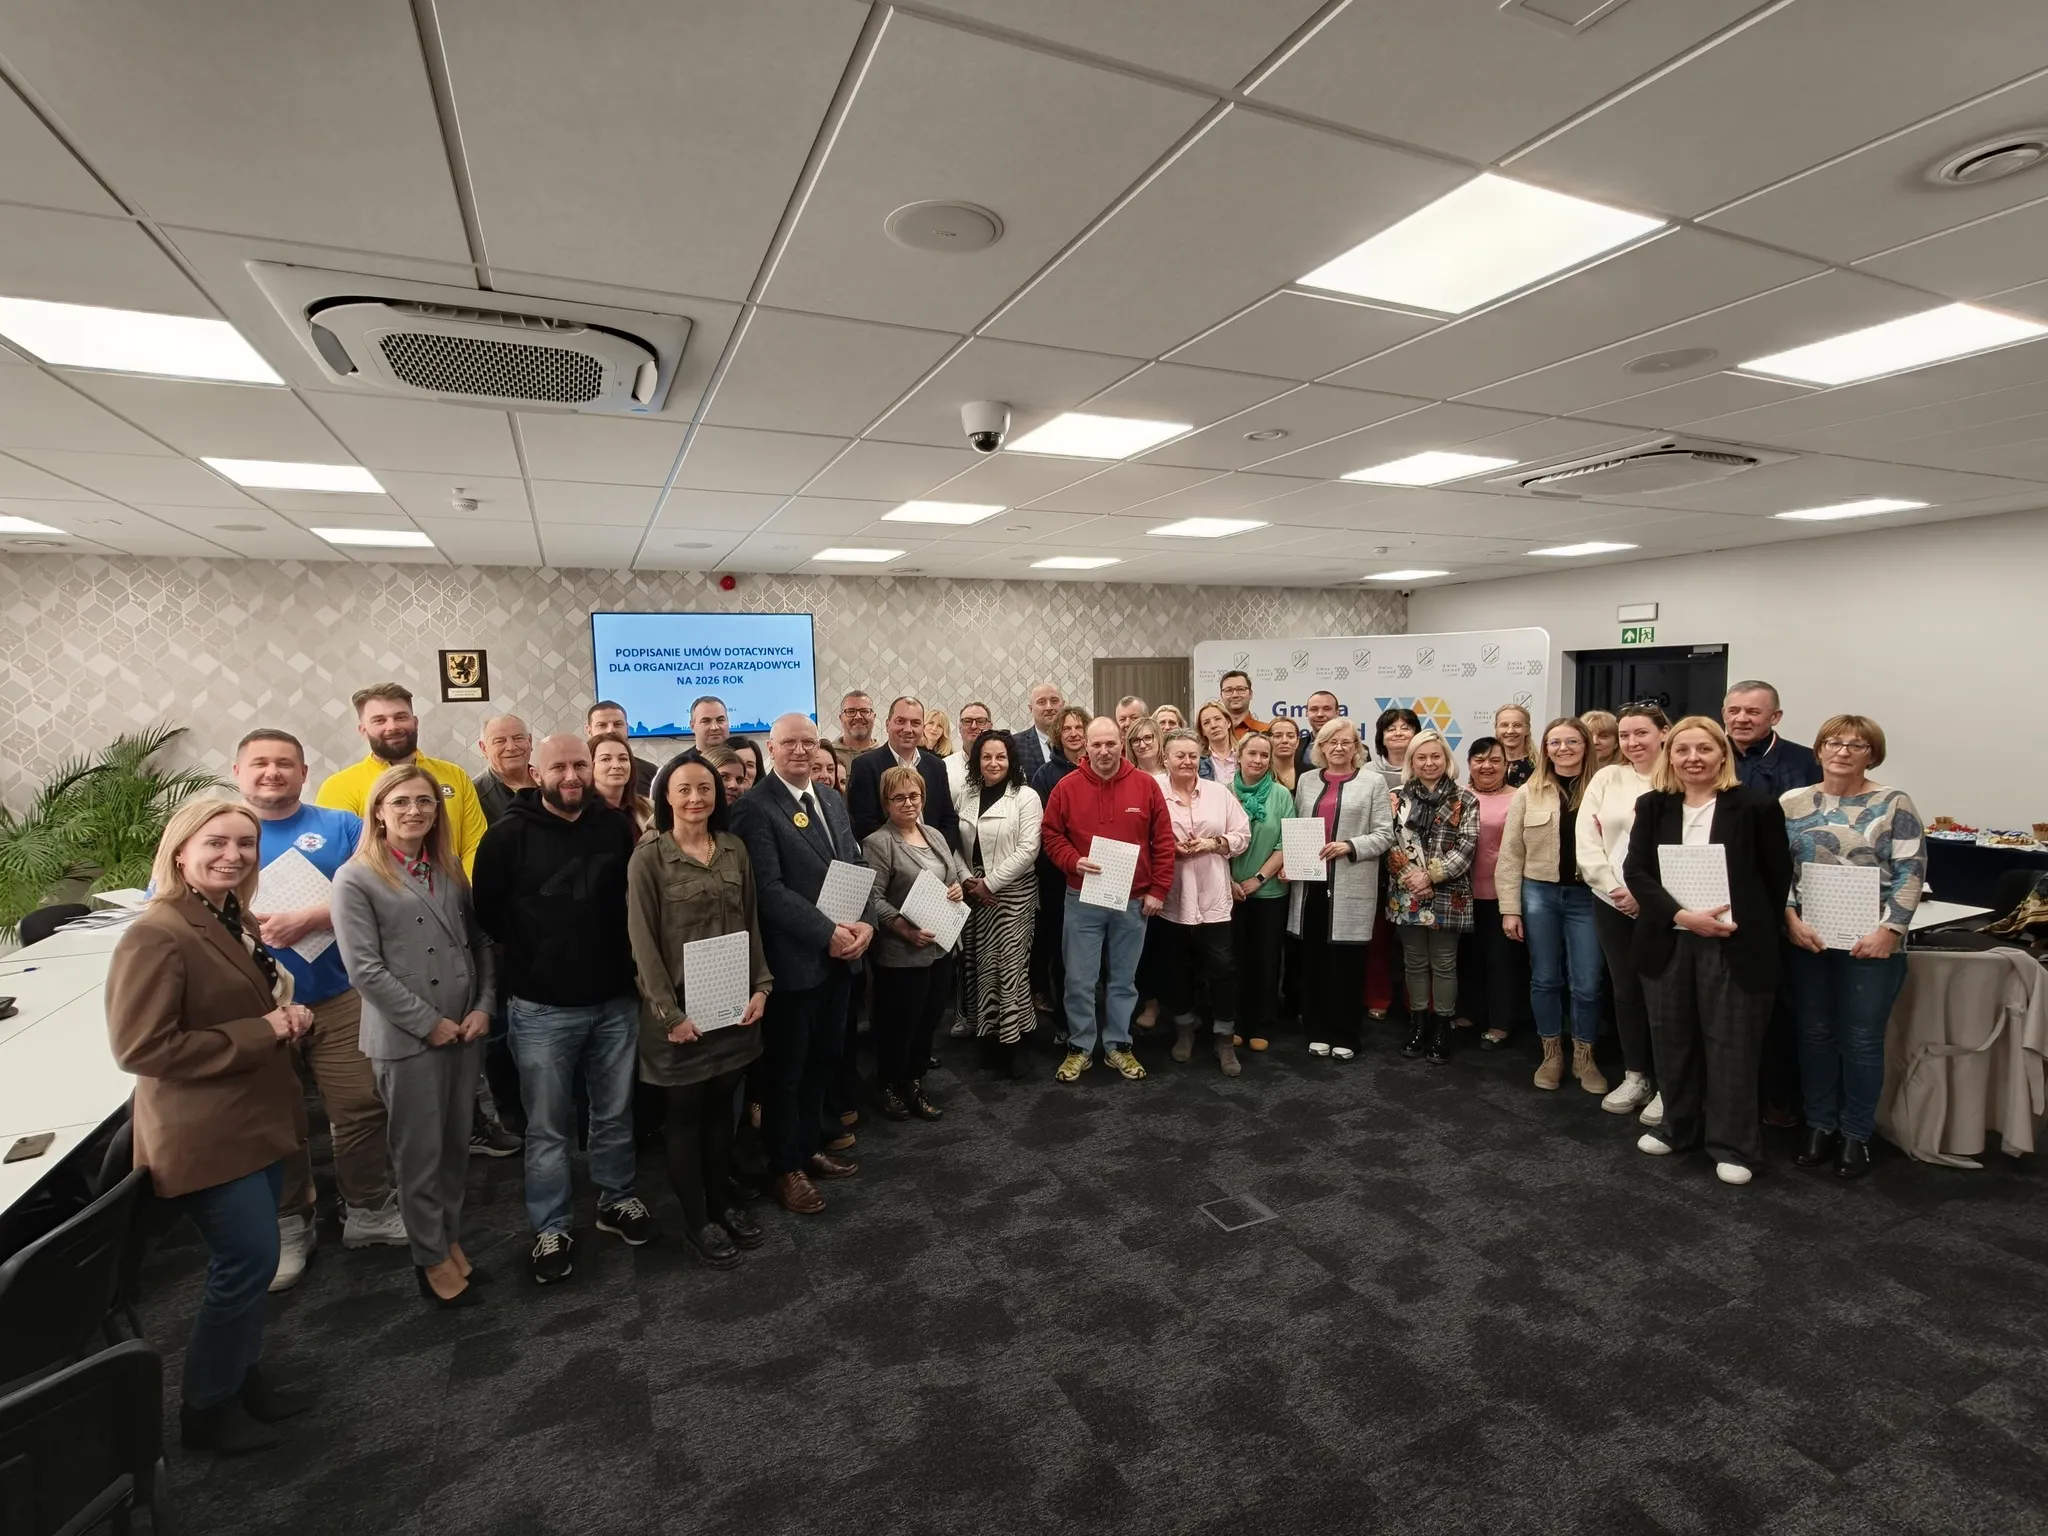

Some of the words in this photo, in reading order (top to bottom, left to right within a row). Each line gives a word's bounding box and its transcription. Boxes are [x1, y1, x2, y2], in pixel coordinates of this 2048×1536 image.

[615, 648, 681, 658] PODPISANIE
[683, 645, 722, 657] UMÓW
[724, 647, 794, 656] DOTACYJNYCH
[609, 663, 631, 672] DLA
[633, 662, 704, 672] ORGANIZACJI
[709, 661, 801, 671] POZARZĄDOWYCH
[676, 677, 693, 685] NA
[695, 676, 720, 685] 2026
[722, 675, 744, 684] ROK
[1271, 700, 1349, 718] Gma
